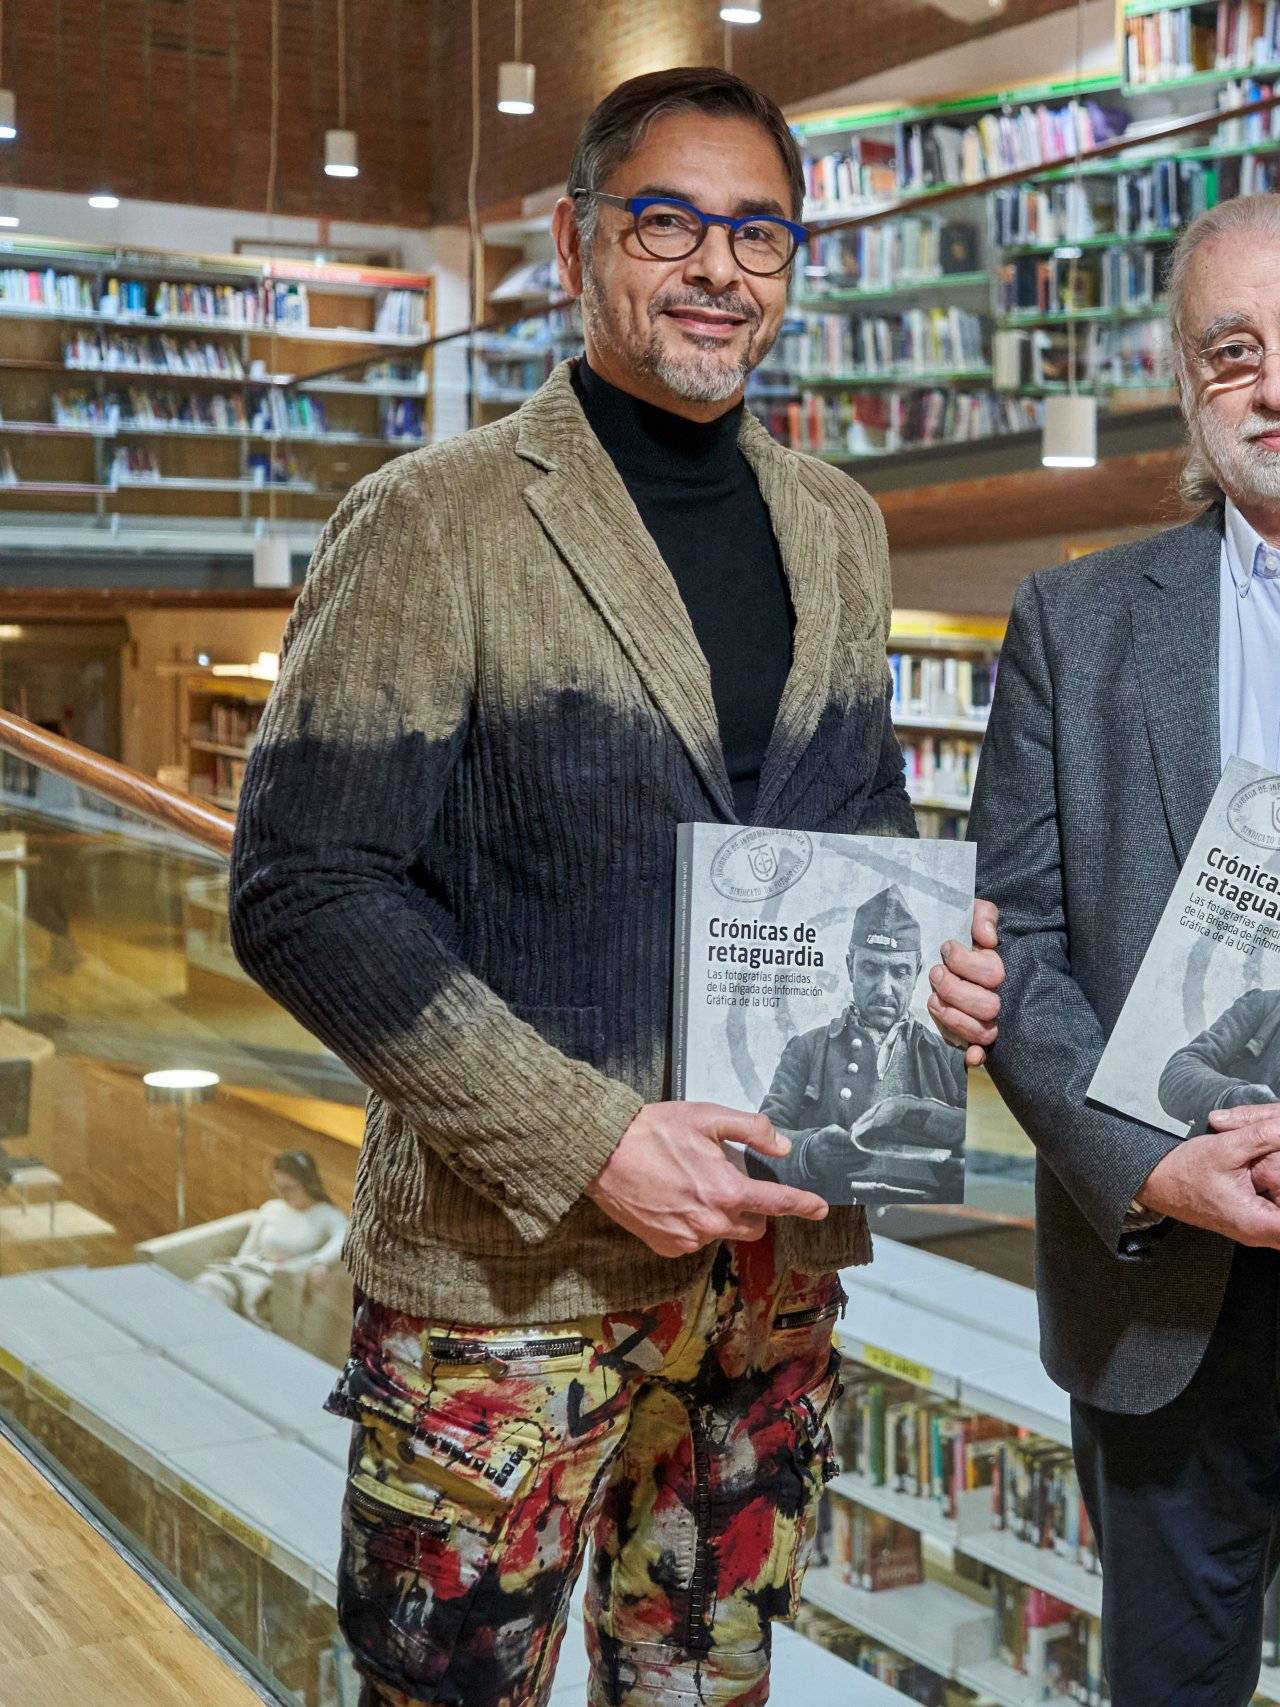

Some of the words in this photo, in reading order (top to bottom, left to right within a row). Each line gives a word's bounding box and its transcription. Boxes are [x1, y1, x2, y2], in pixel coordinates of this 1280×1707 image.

[1184, 905, 1196, 916] de
[1197, 909, 1205, 921] la
[1206, 913, 1239, 936] Brigada
[1240, 927, 1252, 940] de
[1189, 892, 1206, 907] Las
[1207, 899, 1256, 929] fotografías
[709, 917, 788, 941] Crónicas
[793, 922, 816, 943] de
[1180, 915, 1210, 937] Gráfica
[1212, 930, 1224, 942] de
[1225, 936, 1234, 947] la
[1236, 941, 1257, 956] UGT
[708, 944, 824, 969] retaguardia
[707, 969, 722, 980] Las
[725, 970, 772, 983] fotografías
[774, 973, 811, 984] perdidas
[706, 982, 717, 992] de
[720, 983, 727, 992] la
[729, 983, 760, 996] Brigada
[761, 984, 772, 995] de
[774, 985, 823, 997] Información
[706, 994, 736, 1006] Gráfica
[739, 996, 750, 1006] de
[753, 997, 760, 1007] la
[762, 997, 781, 1008] UGT
